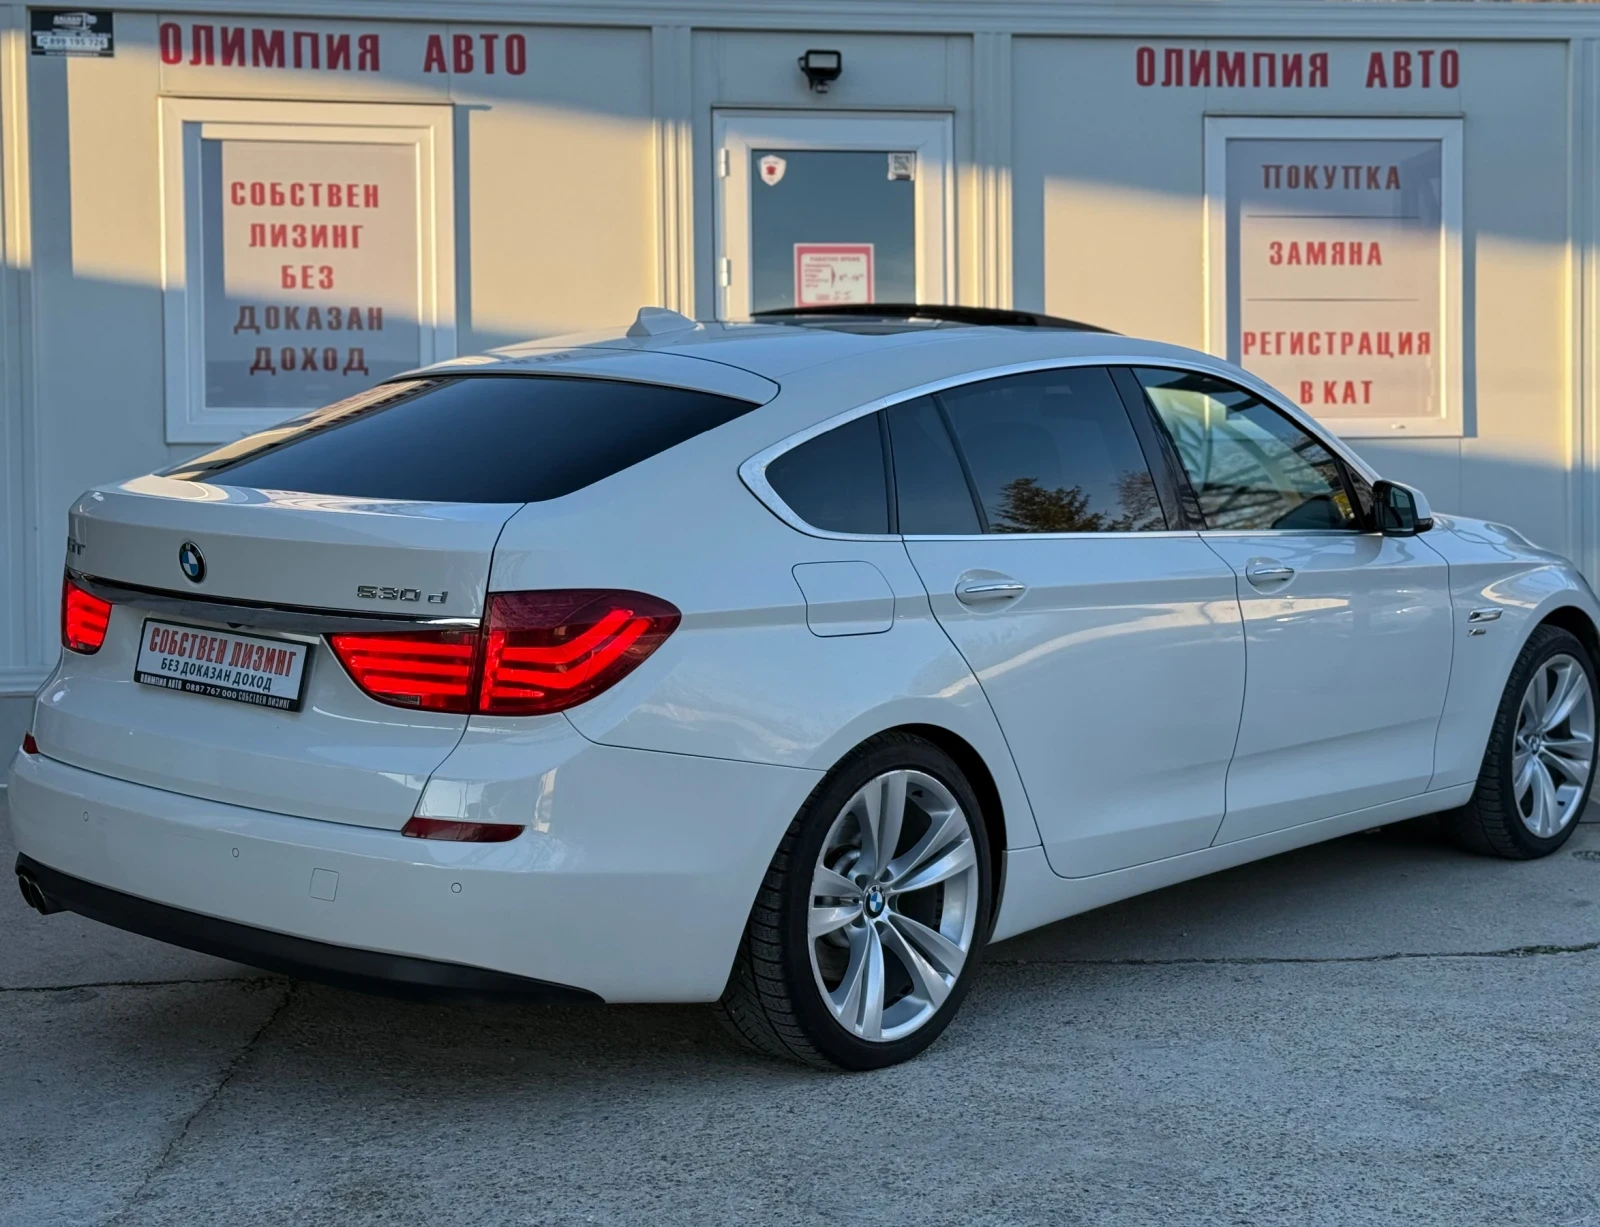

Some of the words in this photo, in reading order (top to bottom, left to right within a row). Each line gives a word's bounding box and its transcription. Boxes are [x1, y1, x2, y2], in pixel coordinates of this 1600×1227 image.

[159, 22, 380, 71] ОЛИМПИЯ
[423, 33, 527, 76] АВТО
[1136, 46, 1329, 88] ОЛИМПИЯ
[1365, 48, 1460, 88] АВТО
[1262, 164, 1401, 190] ПОКУПКА
[230, 181, 380, 208] СОБСТВЕН
[248, 223, 364, 248] ЛИЗИНГ
[1269, 241, 1382, 266] ЗАМЯНА
[281, 265, 334, 290] БЕЗ
[233, 305, 384, 335] ДОКАЗАН
[1243, 331, 1432, 359] РЕГИСТРАЦИЯ
[248, 347, 370, 377] ДОХОД
[1299, 380, 1315, 404] В
[1322, 380, 1373, 404] КАТ
[357, 585, 421, 602] 530
[427, 591, 449, 604] d
[149, 627, 228, 664] СОБСТВЕН
[228, 641, 297, 677] ЛИЗИНГ
[160, 658, 180, 672] БЕЗ
[180, 663, 232, 683] ДОКАЗАН
[231, 675, 273, 693] ДОХОД
[185, 683, 204, 693] 0887
[205, 686, 221, 697] 767
[221, 690, 238, 700] 000
